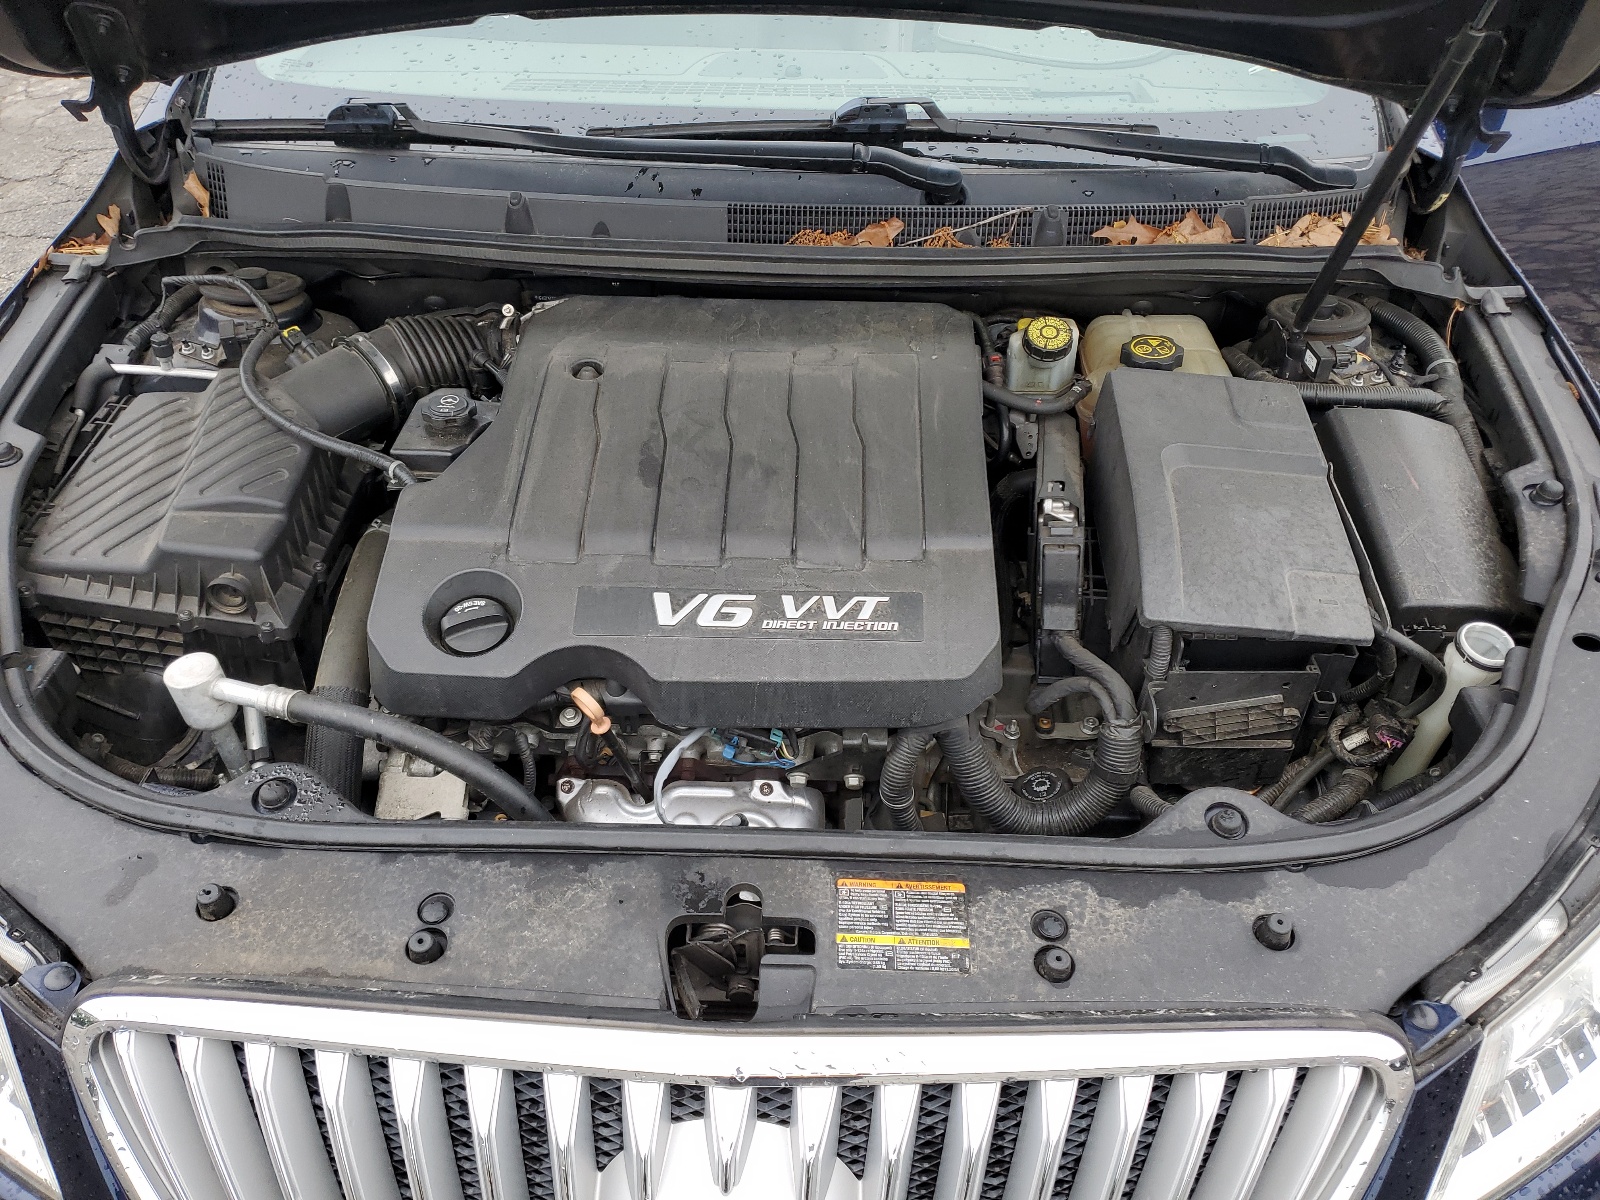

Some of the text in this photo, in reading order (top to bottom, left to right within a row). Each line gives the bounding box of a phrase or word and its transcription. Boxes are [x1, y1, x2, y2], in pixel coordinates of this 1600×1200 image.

[653, 592, 890, 628] V6 VVT
[761, 620, 899, 631] DIRECT INJECTION
[905, 883, 952, 891] AVERTISSEMENT
[907, 938, 940, 946] ATTENTION
